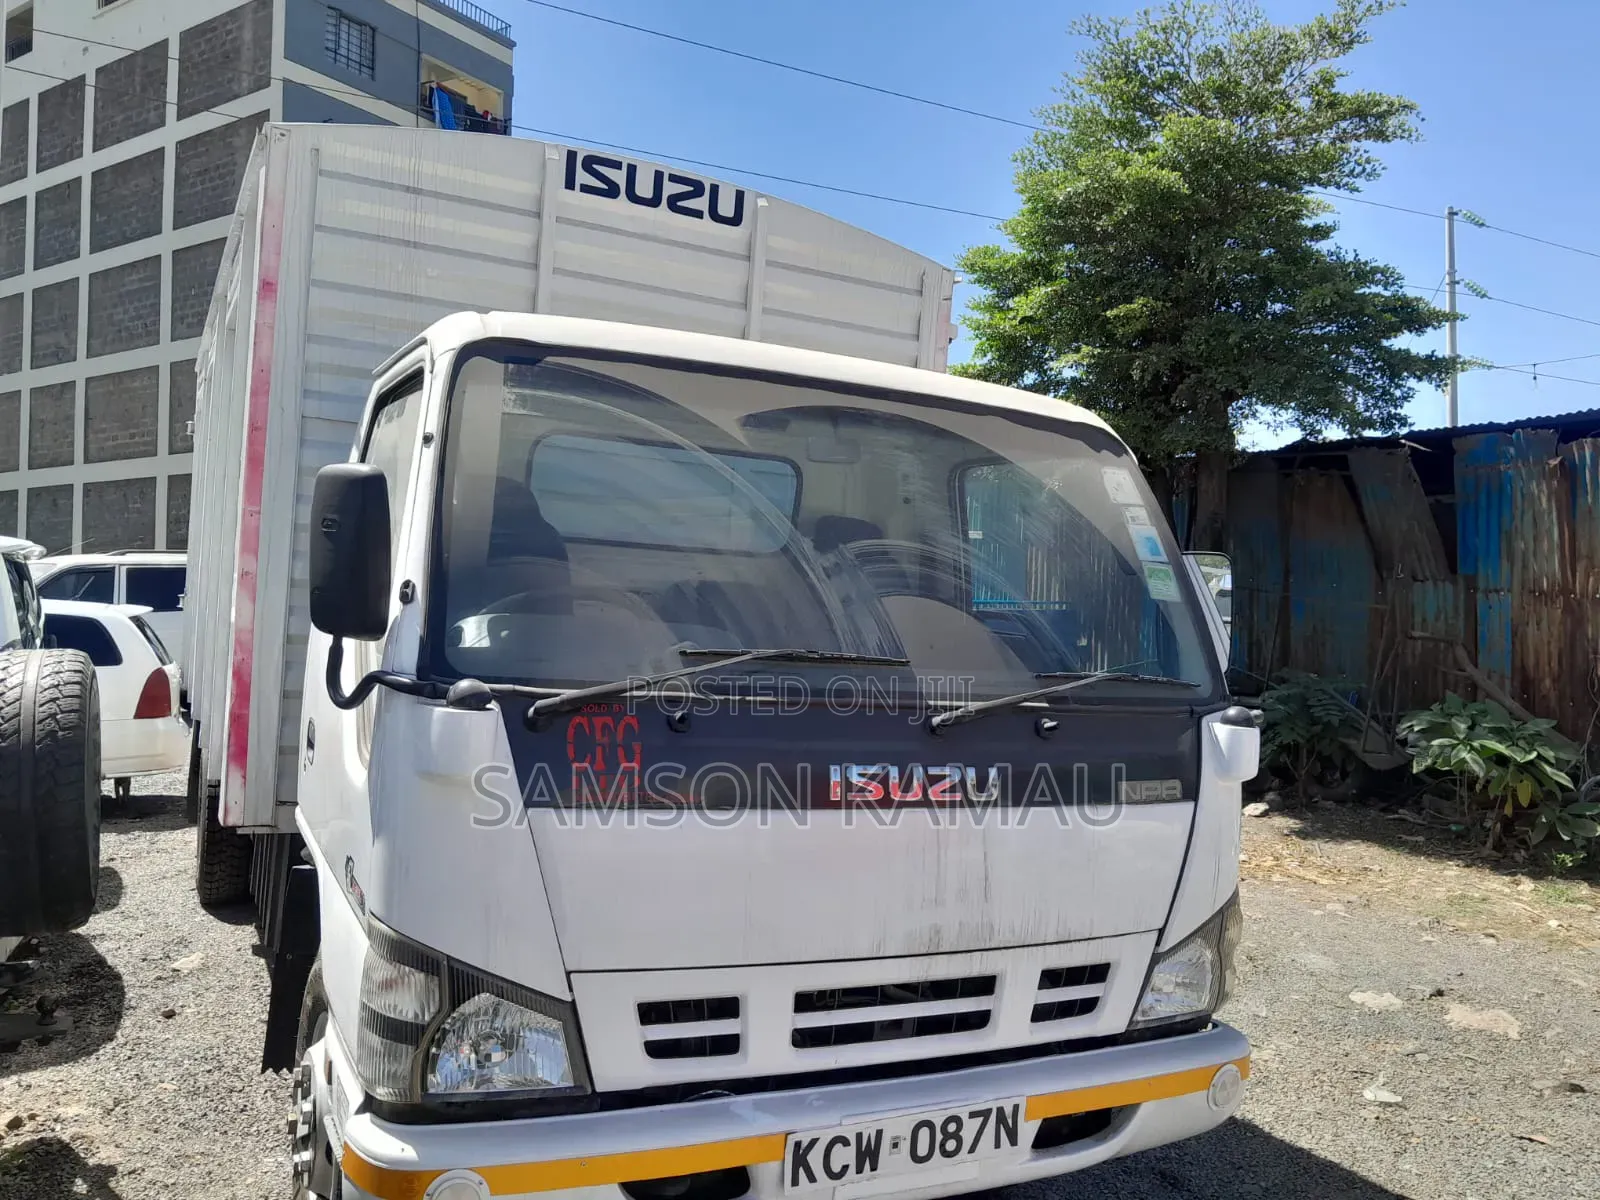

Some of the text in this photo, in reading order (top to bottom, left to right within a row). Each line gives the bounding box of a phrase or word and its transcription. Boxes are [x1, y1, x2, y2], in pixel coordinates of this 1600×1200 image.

[564, 149, 745, 227] ISUZU
[581, 704, 625, 713] SOLD BY
[566, 715, 642, 771] CFG
[829, 764, 999, 801] ISUZU
[791, 1103, 1021, 1188] KCW 087N
